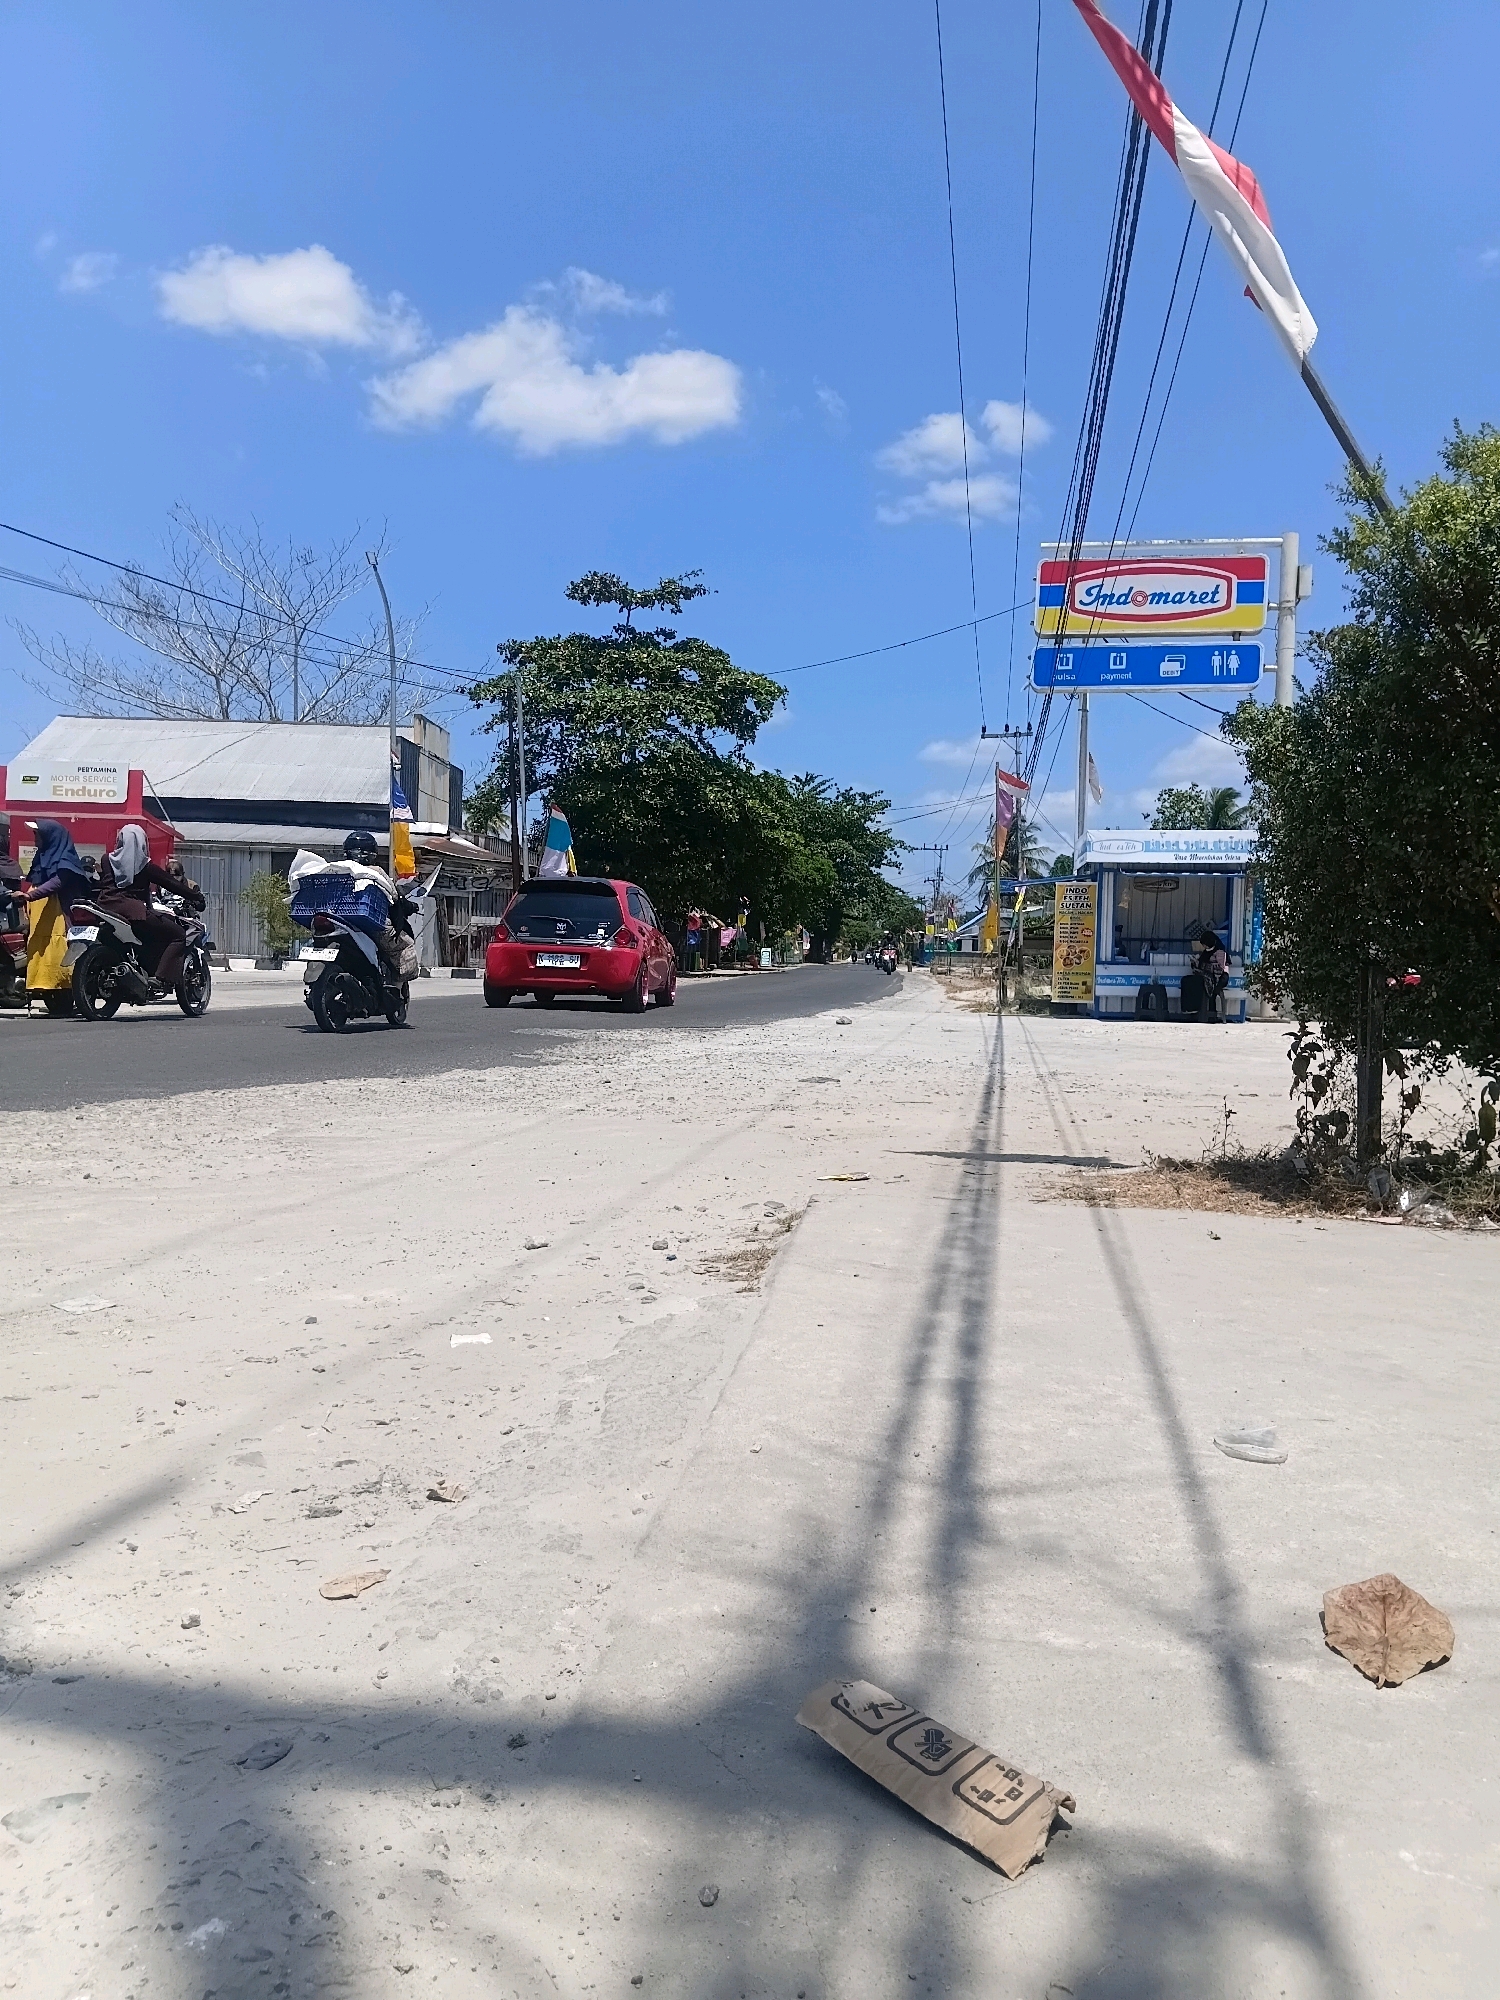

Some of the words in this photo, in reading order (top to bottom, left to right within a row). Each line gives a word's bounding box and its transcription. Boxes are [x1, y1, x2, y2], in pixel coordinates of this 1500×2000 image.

[1078, 584, 1221, 607] Indomaret
[1100, 672, 1132, 681] payment
[77, 766, 118, 774] PERTAMINA
[50, 775, 80, 783] MOTOR
[82, 775, 118, 783] SERVICE
[51, 785, 118, 798] Enduro
